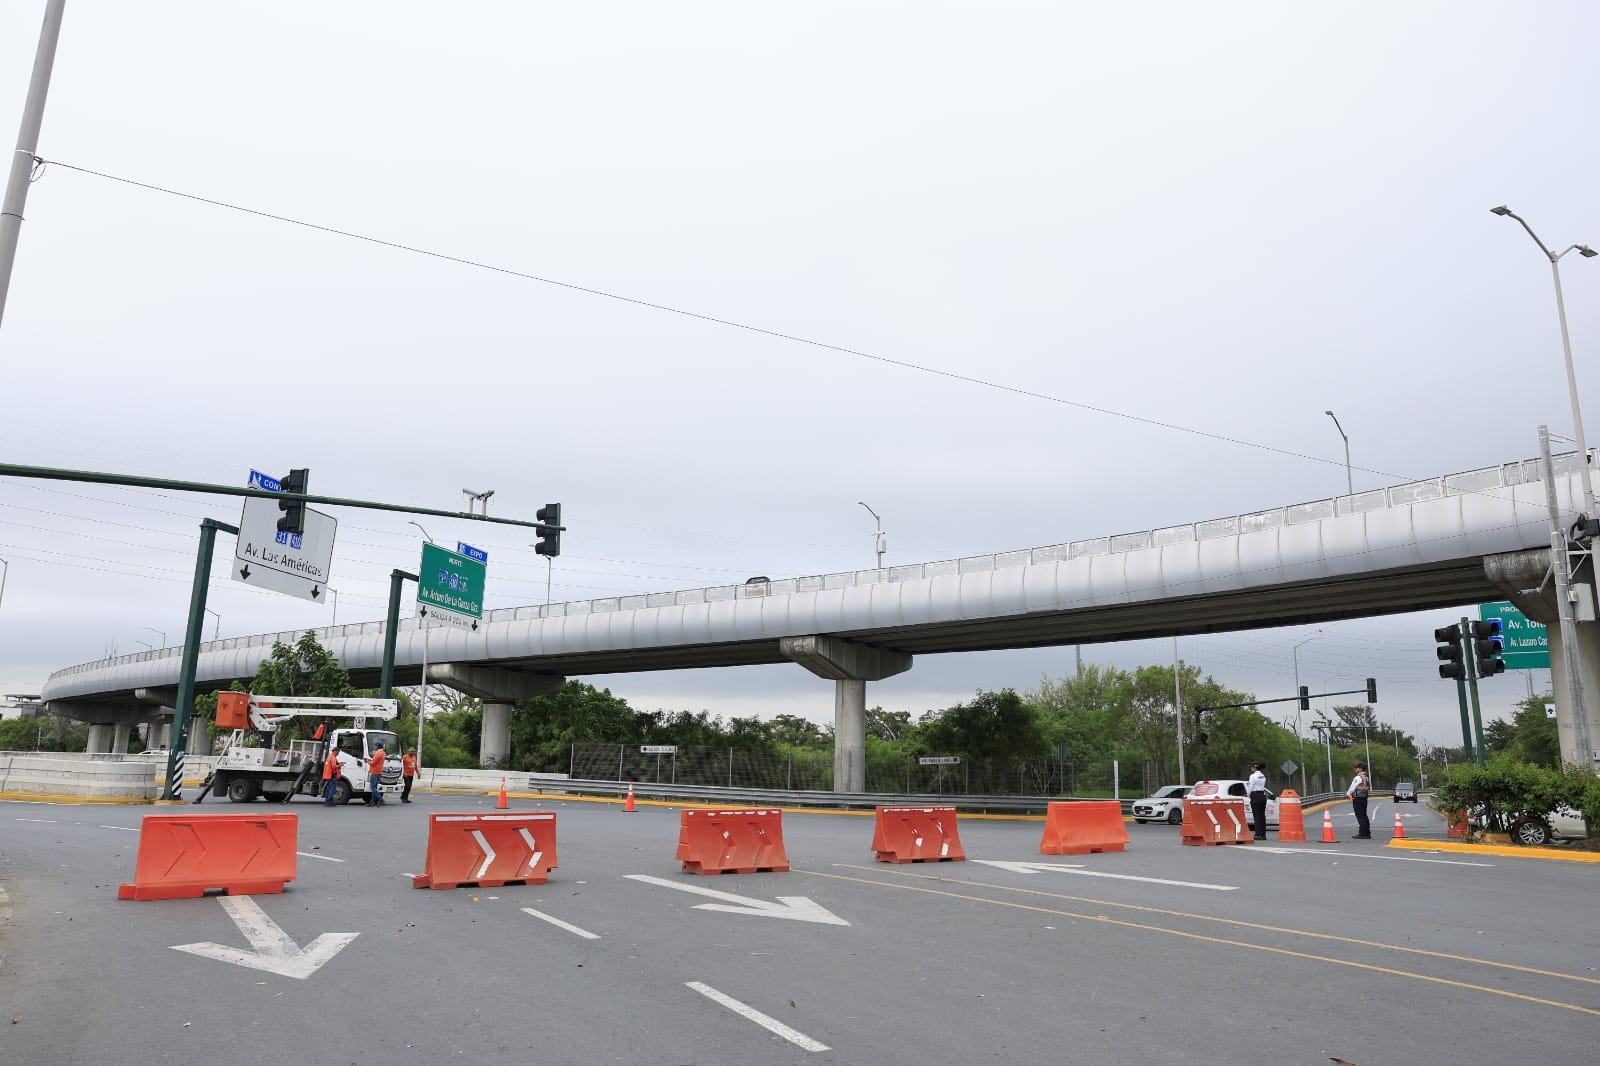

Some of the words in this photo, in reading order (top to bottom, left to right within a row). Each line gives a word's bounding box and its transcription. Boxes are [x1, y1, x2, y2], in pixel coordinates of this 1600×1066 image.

[277, 531, 286, 543] 31
[471, 549, 482, 558] EXPO
[244, 542, 258, 558] Av.
[262, 547, 279, 564] Las
[281, 555, 322, 576] Américas
[1508, 620, 1522, 629] Av.
